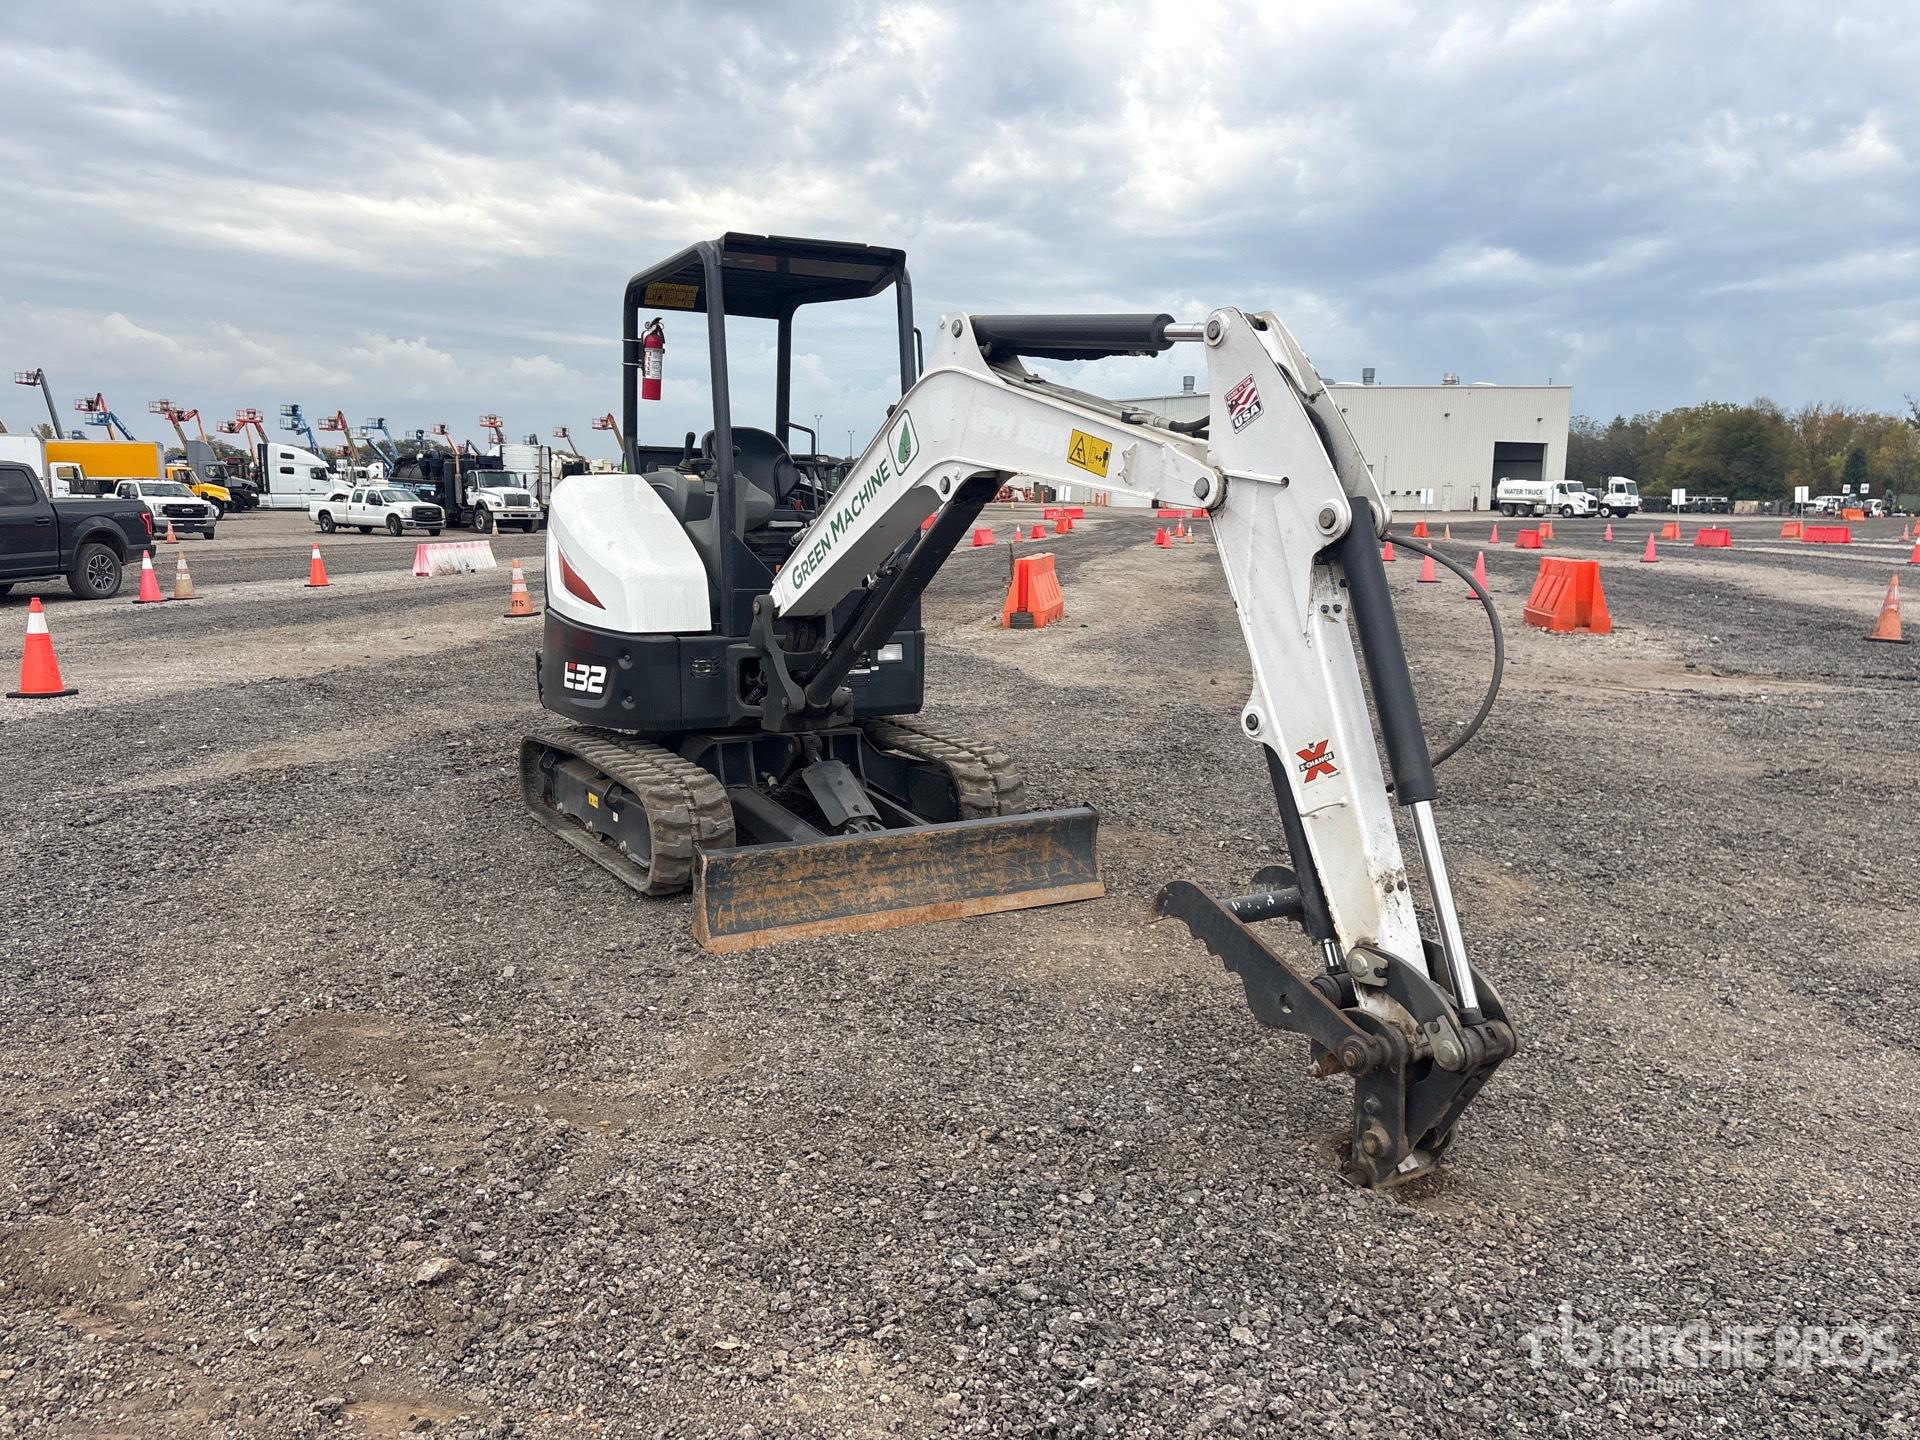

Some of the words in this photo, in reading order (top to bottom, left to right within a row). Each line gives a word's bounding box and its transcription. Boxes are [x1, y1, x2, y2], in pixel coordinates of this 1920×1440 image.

[1233, 404, 1260, 428] USA
[1524, 488, 1544, 496] TRUCK
[791, 532, 832, 590] GREEN
[829, 457, 891, 543] MACHINE
[563, 661, 607, 694] E32
